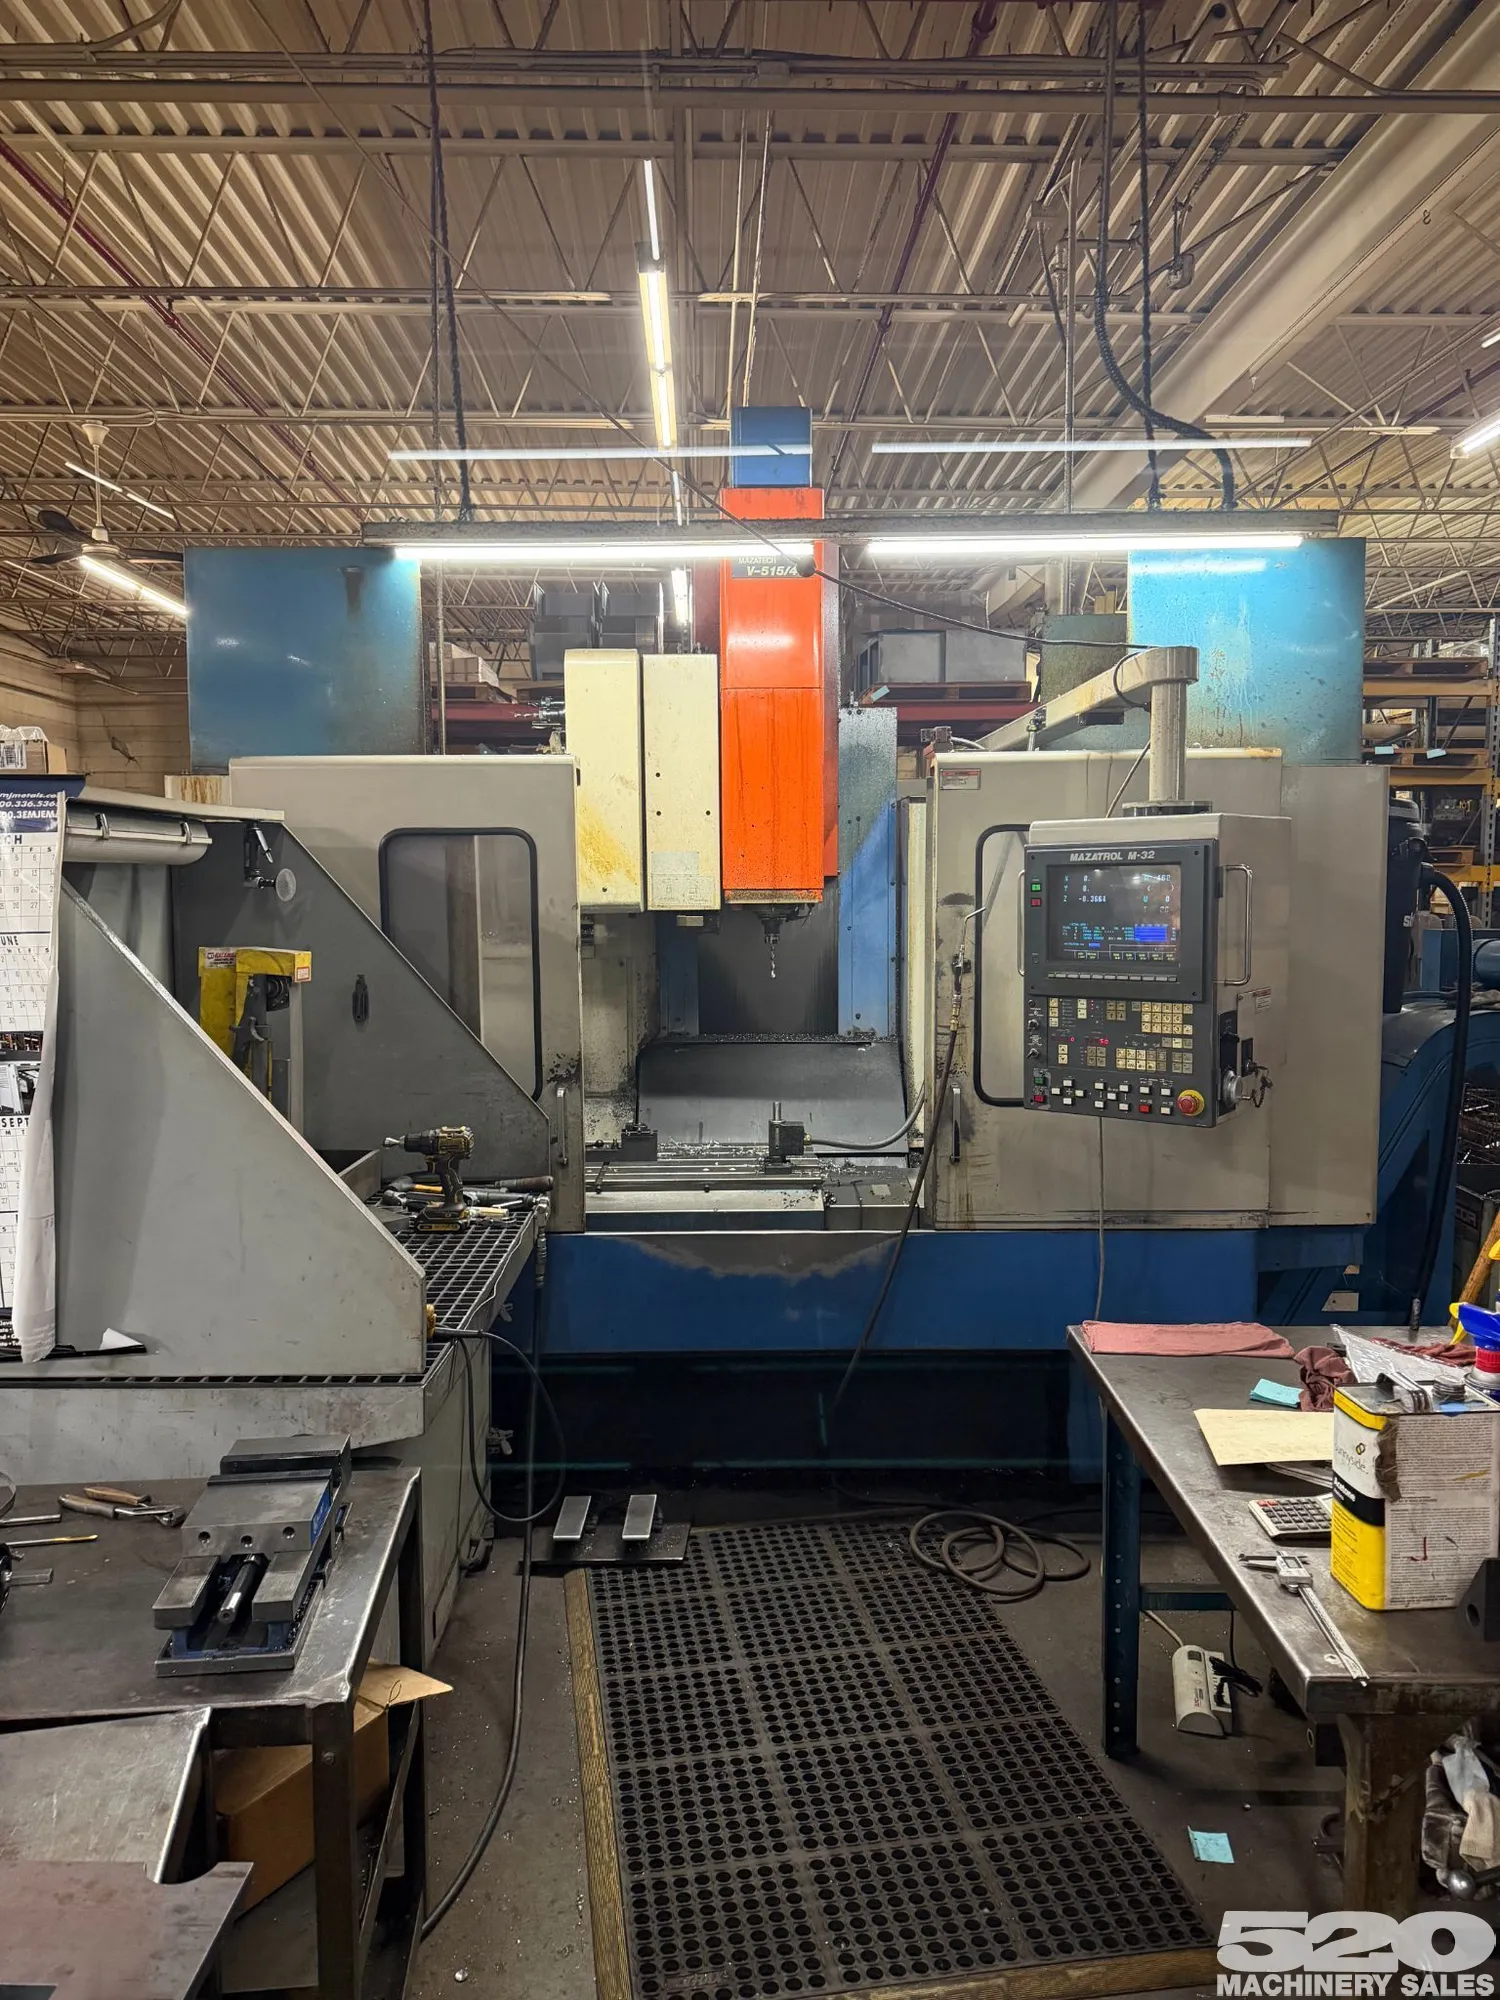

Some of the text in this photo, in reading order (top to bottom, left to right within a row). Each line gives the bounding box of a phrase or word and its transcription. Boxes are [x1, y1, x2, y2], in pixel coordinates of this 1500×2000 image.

[0, 810, 57, 819] 00.3EMJEM
[1069, 850, 1155, 862] MAZATROL M-32
